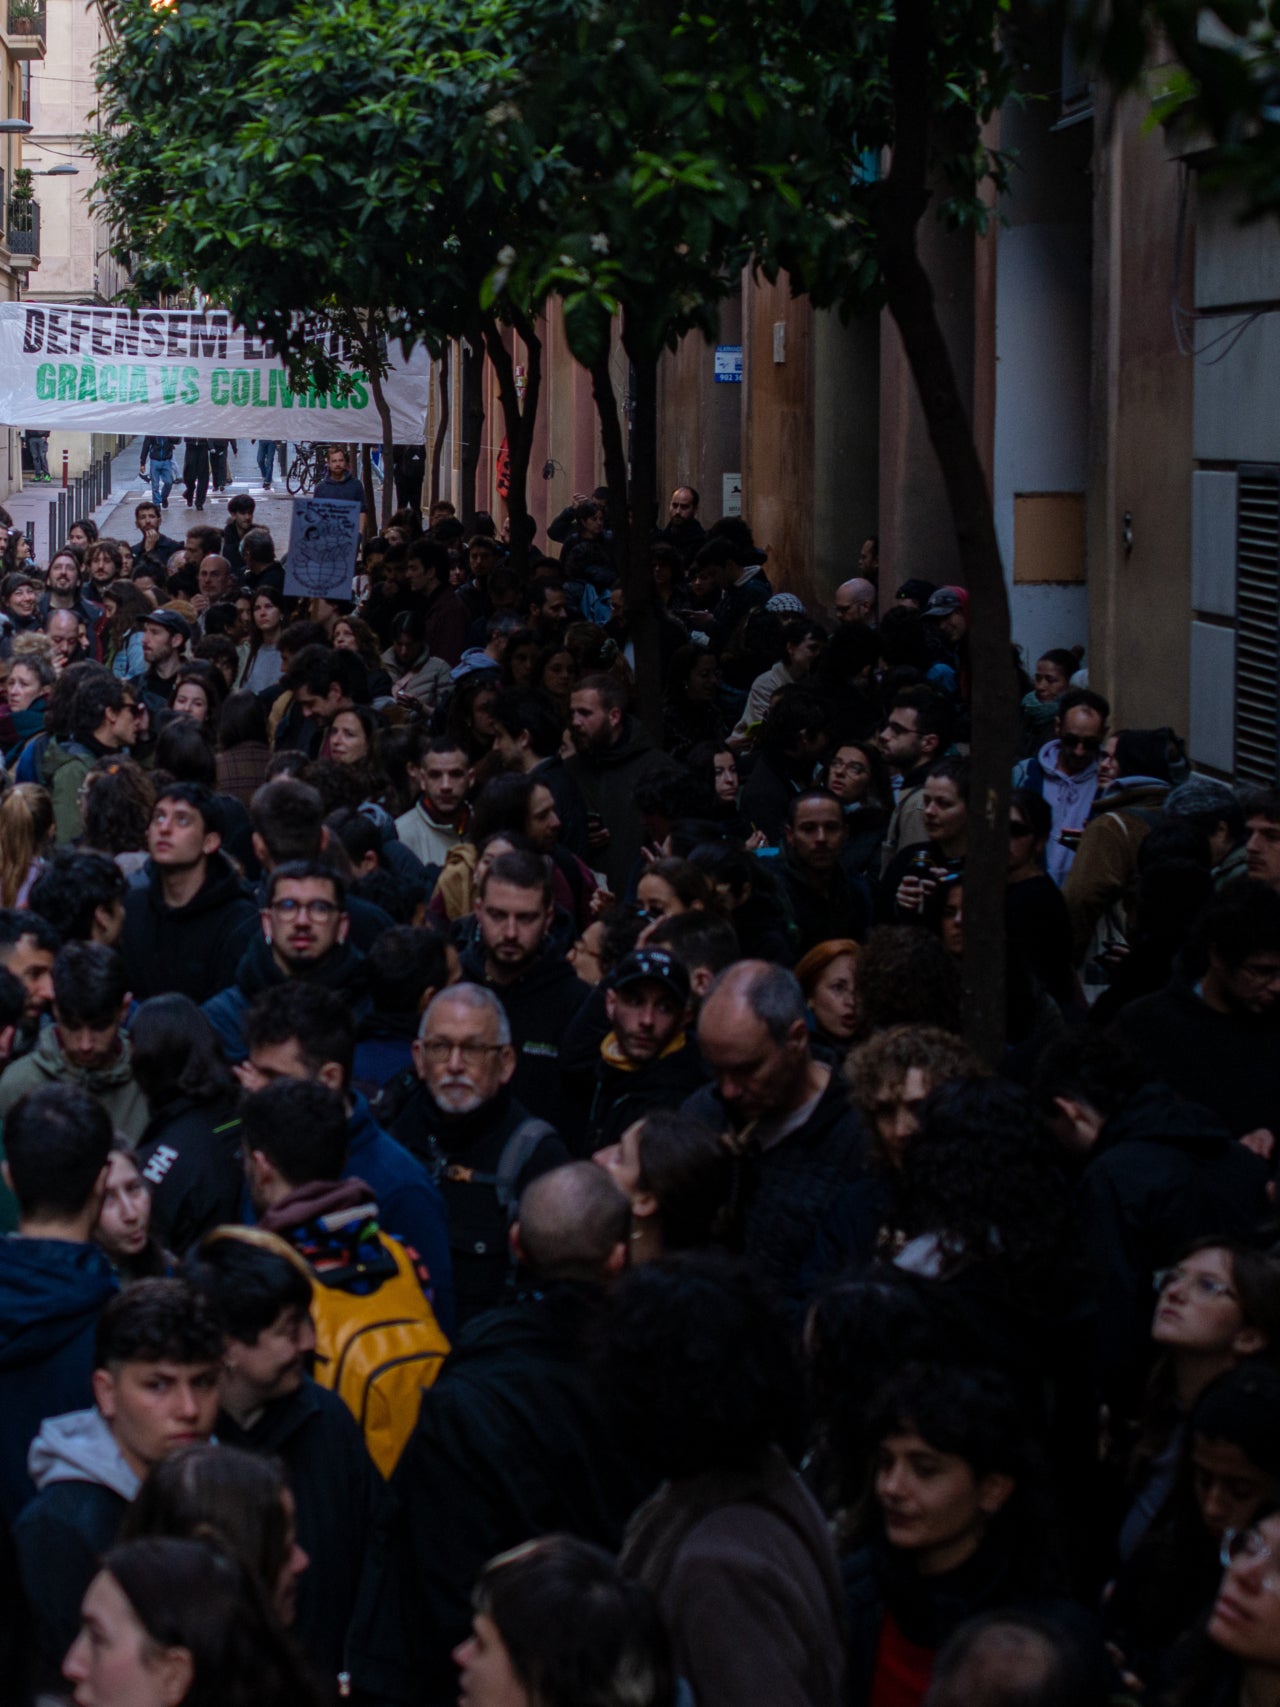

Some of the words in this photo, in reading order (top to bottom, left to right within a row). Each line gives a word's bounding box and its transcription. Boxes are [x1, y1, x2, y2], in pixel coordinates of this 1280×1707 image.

[23, 308, 228, 360] DEFENSEM
[36, 355, 149, 404] GRÀCIA
[160, 366, 200, 405] VS
